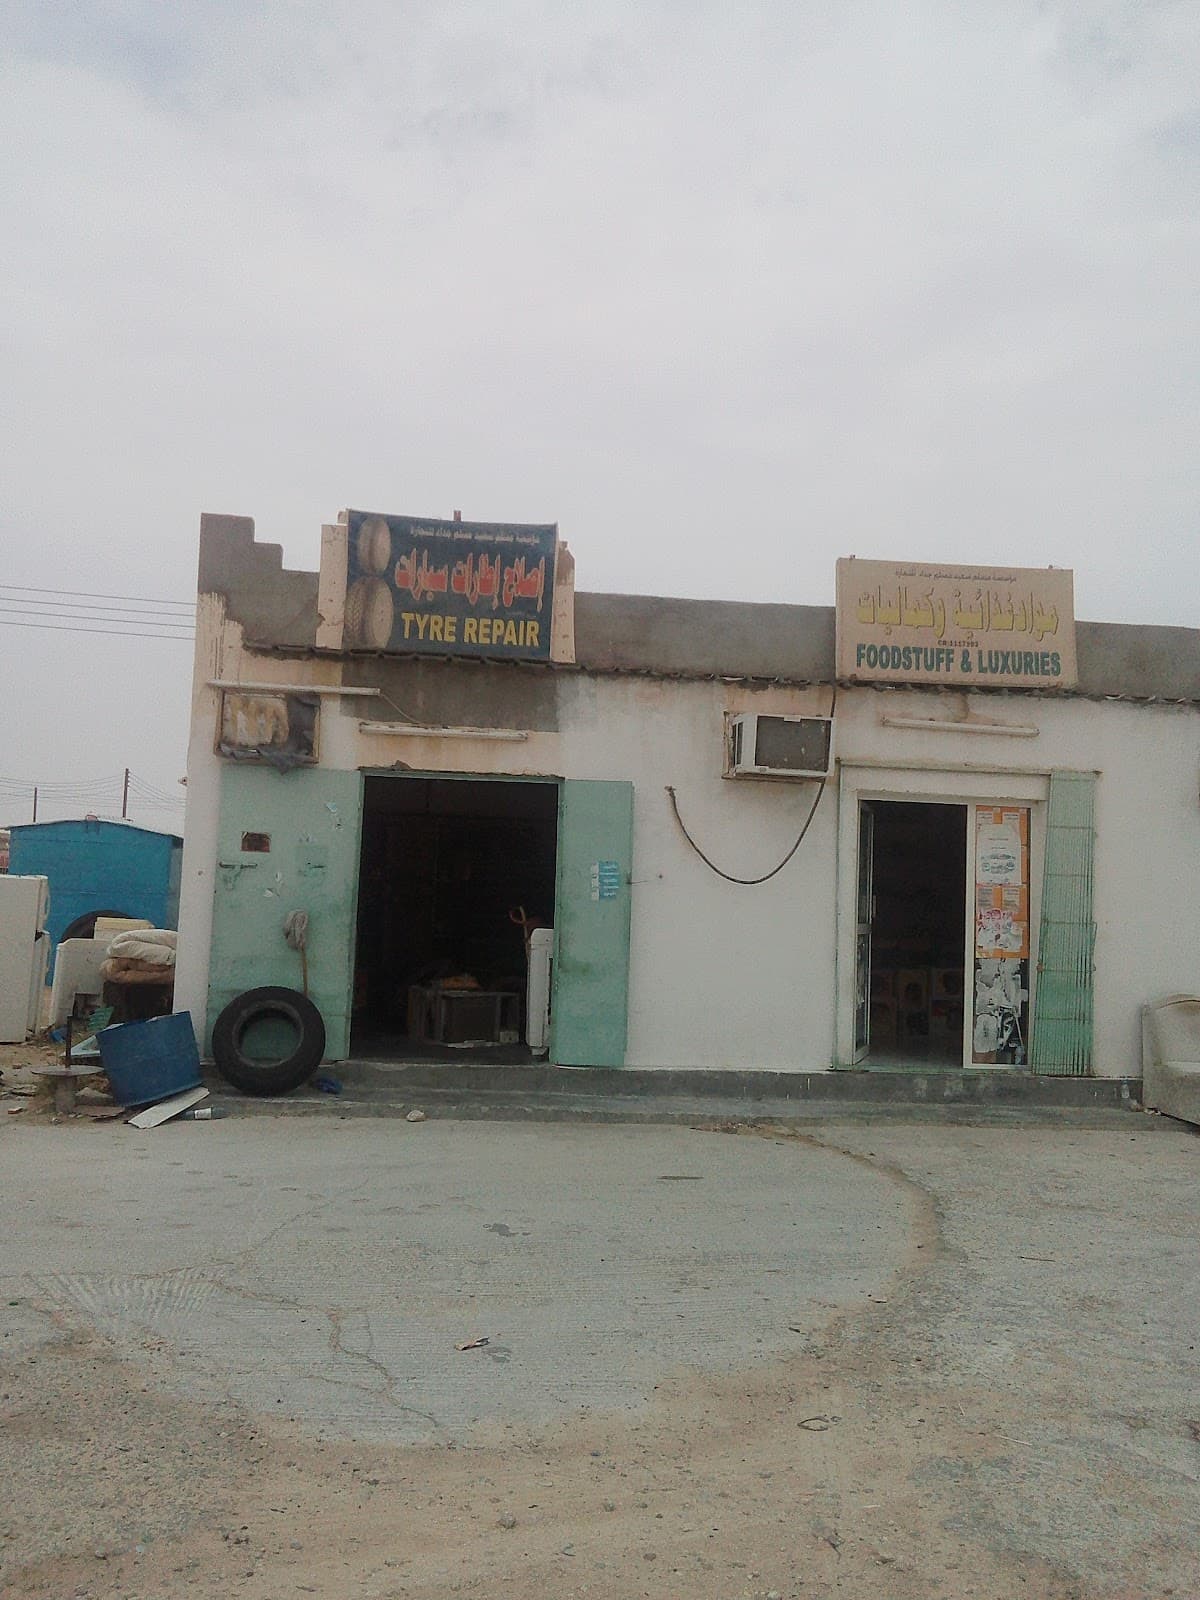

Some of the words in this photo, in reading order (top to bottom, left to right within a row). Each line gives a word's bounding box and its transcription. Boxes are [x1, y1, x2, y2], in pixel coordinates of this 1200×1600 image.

[395, 548, 448, 601] سيارات
[451, 553, 500, 610] إطارات
[502, 555, 545, 613] إصلاح
[401, 612, 457, 642] TYRE
[463, 618, 540, 647] REPAIR
[856, 585, 946, 638] وكماليات
[954, 589, 1014, 640] غذائية
[1014, 591, 1059, 641] مواد
[856, 643, 955, 672] FOODSTUFF
[960, 649, 973, 673] &
[977, 650, 1062, 677] LUXURIES
